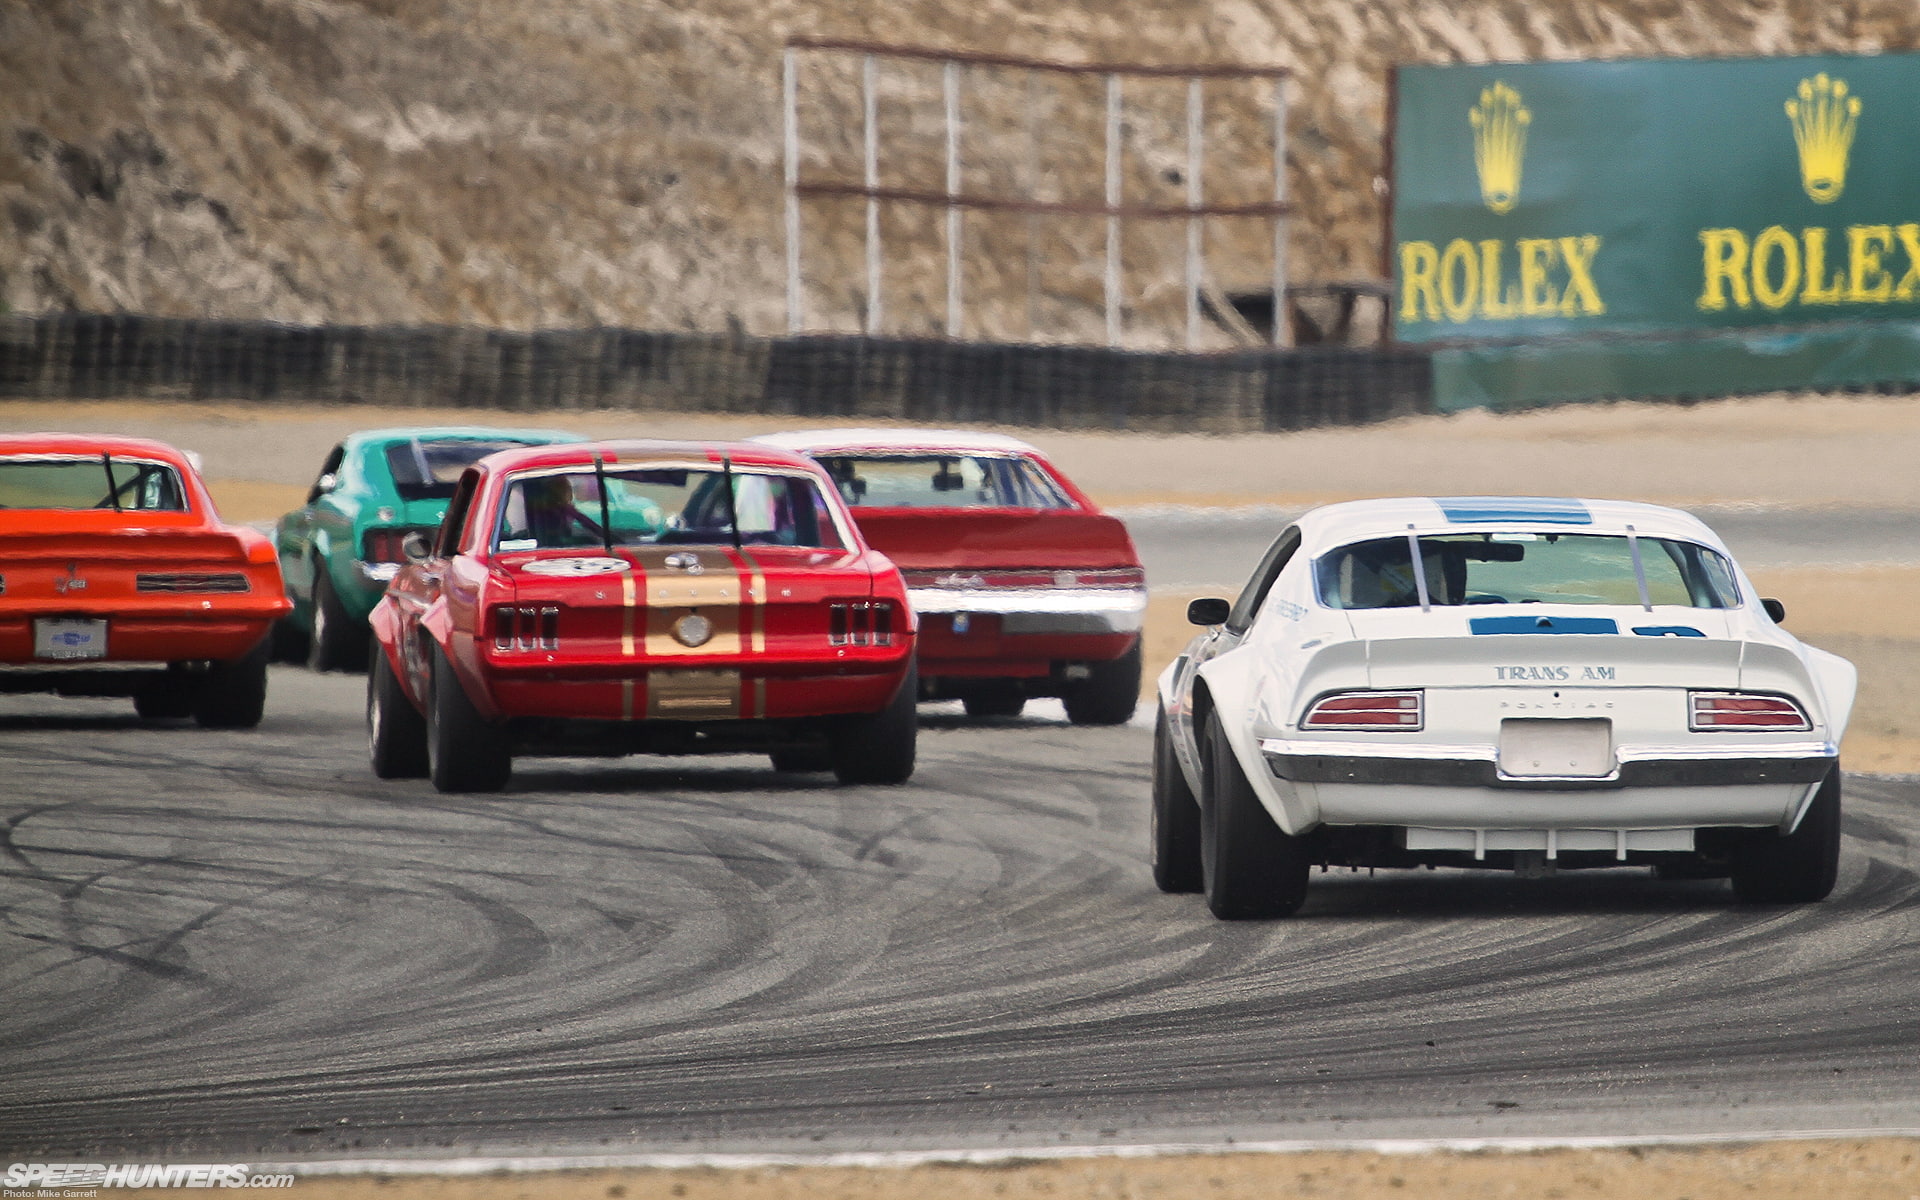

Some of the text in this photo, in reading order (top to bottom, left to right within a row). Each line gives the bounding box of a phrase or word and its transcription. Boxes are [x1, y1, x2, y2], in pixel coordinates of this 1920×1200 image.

[1400, 234, 1605, 322] ROLEX
[1494, 665, 1616, 681] TRANS AM
